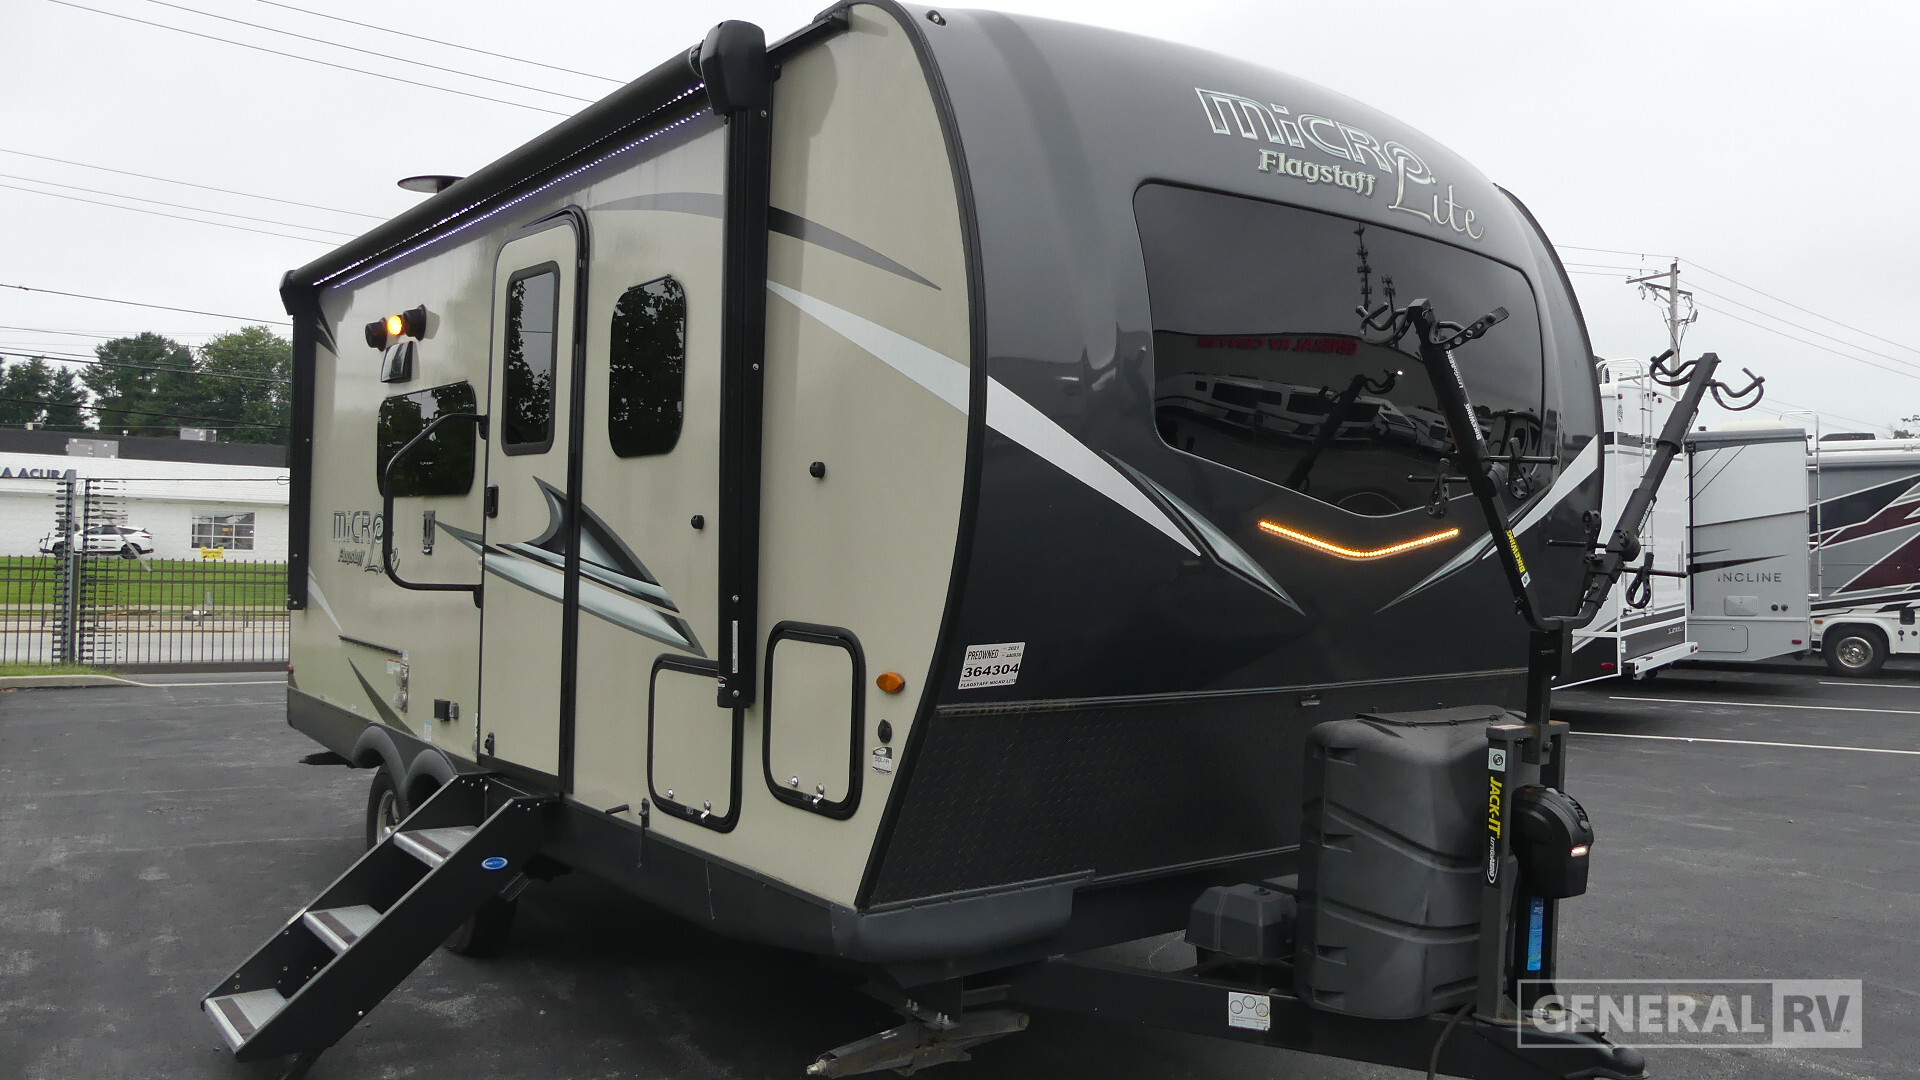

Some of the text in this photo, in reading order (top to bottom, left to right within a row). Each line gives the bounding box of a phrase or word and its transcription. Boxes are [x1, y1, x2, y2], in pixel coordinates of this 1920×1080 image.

[1257, 148, 1376, 196] Flagstaff
[1388, 155, 1485, 240] Lite
[1717, 572, 1782, 582] INCLINE
[966, 649, 999, 660] PREOWNED
[963, 663, 1020, 678] 364304
[960, 680, 988, 688] FLAGSTAFF
[1488, 776, 1503, 838] JACK-IT
